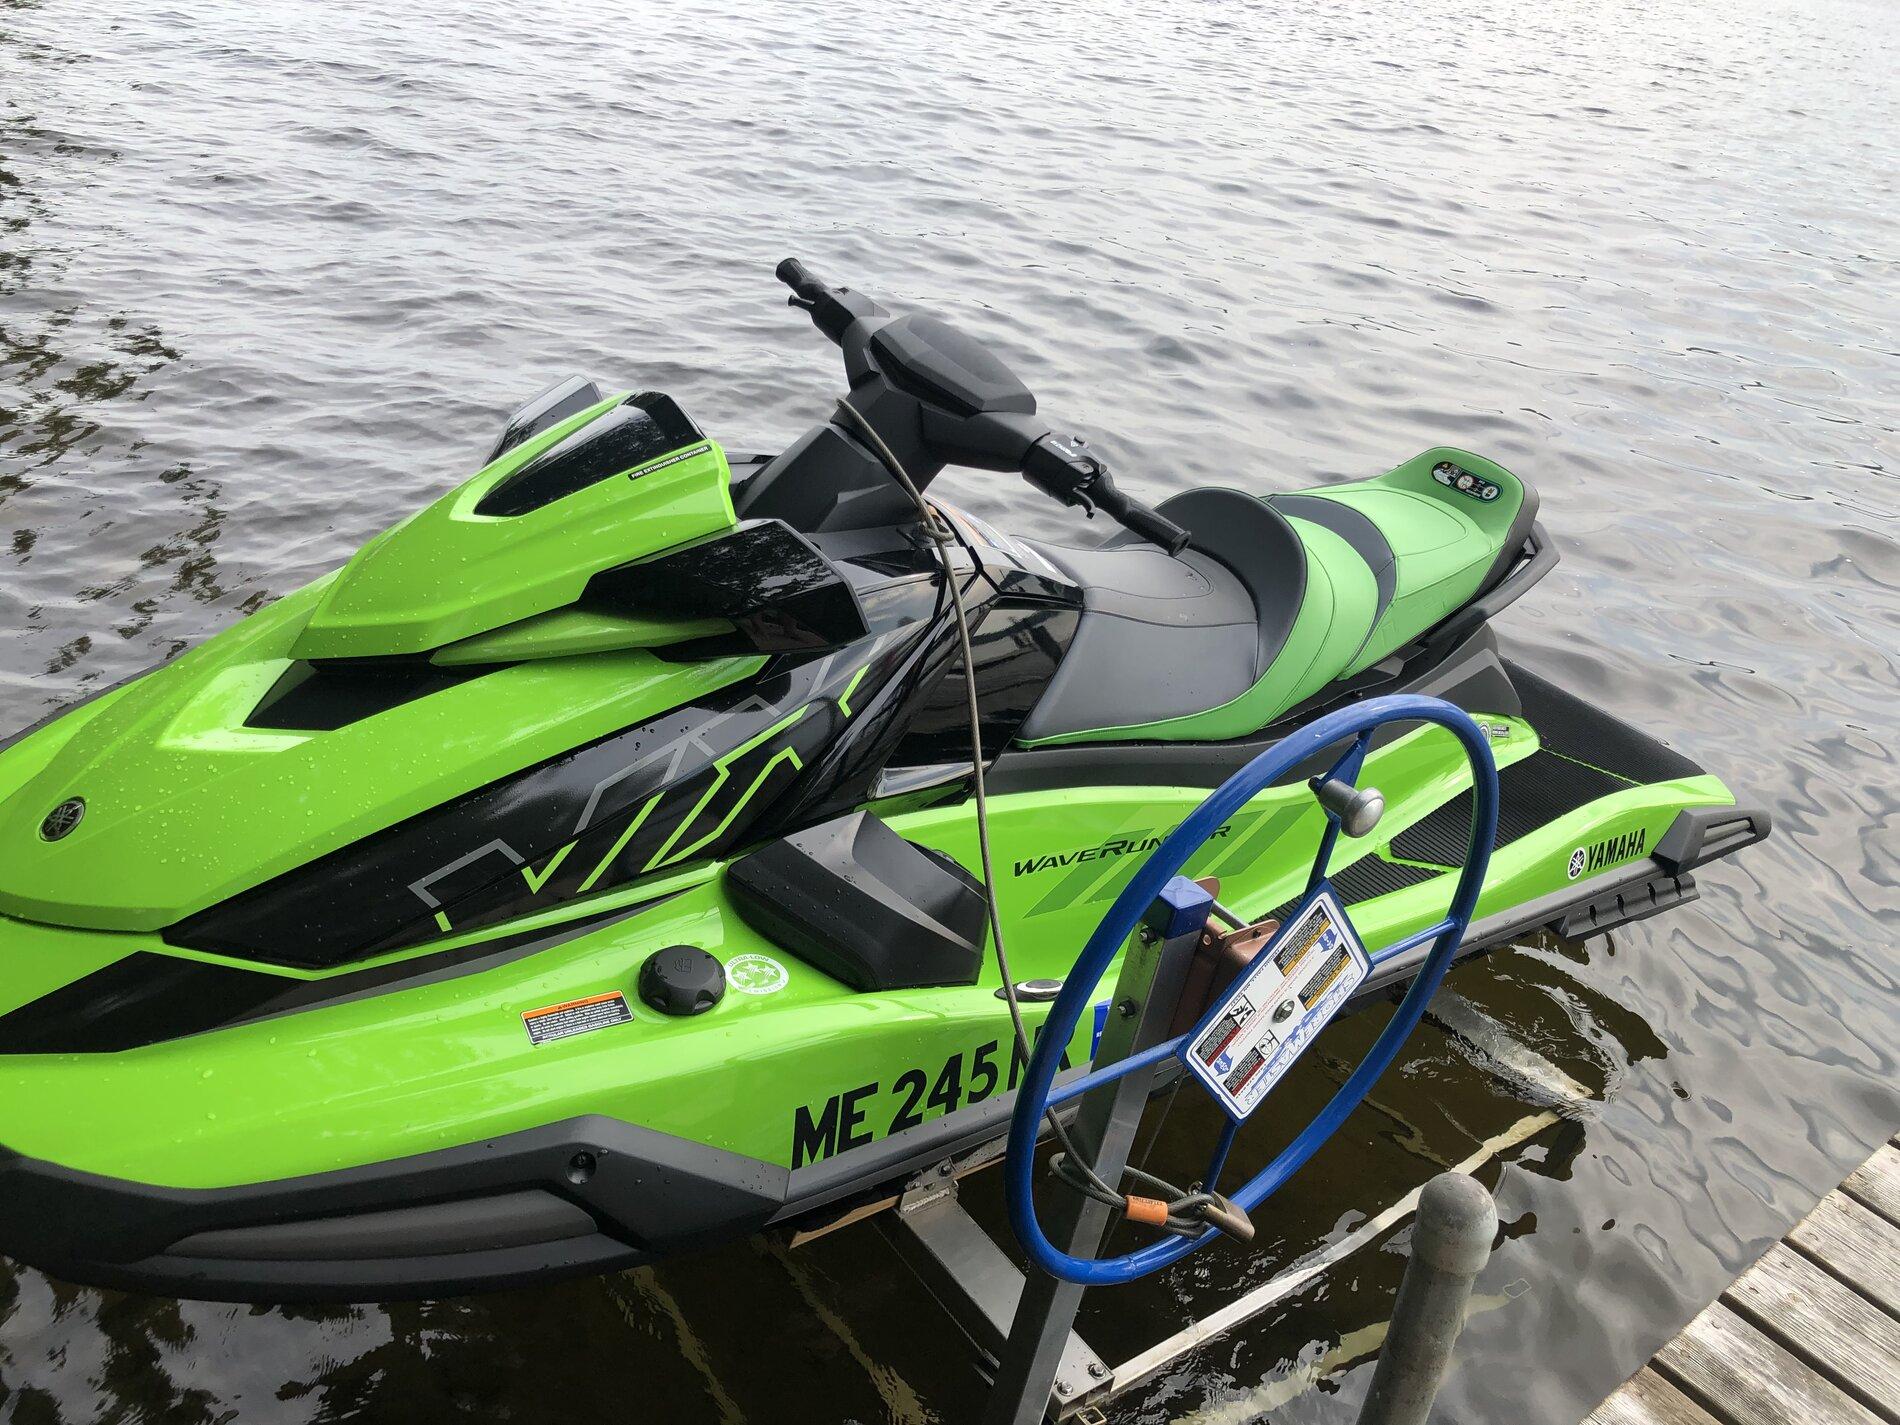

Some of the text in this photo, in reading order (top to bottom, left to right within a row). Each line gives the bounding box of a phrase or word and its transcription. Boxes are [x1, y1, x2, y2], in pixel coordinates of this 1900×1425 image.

[631, 446, 709, 479] FIRE EXTINGUISHER CONTAINER
[1587, 828, 1646, 872] YAMAHA
[791, 1081, 879, 1171] ME
[888, 1040, 999, 1136] 245
